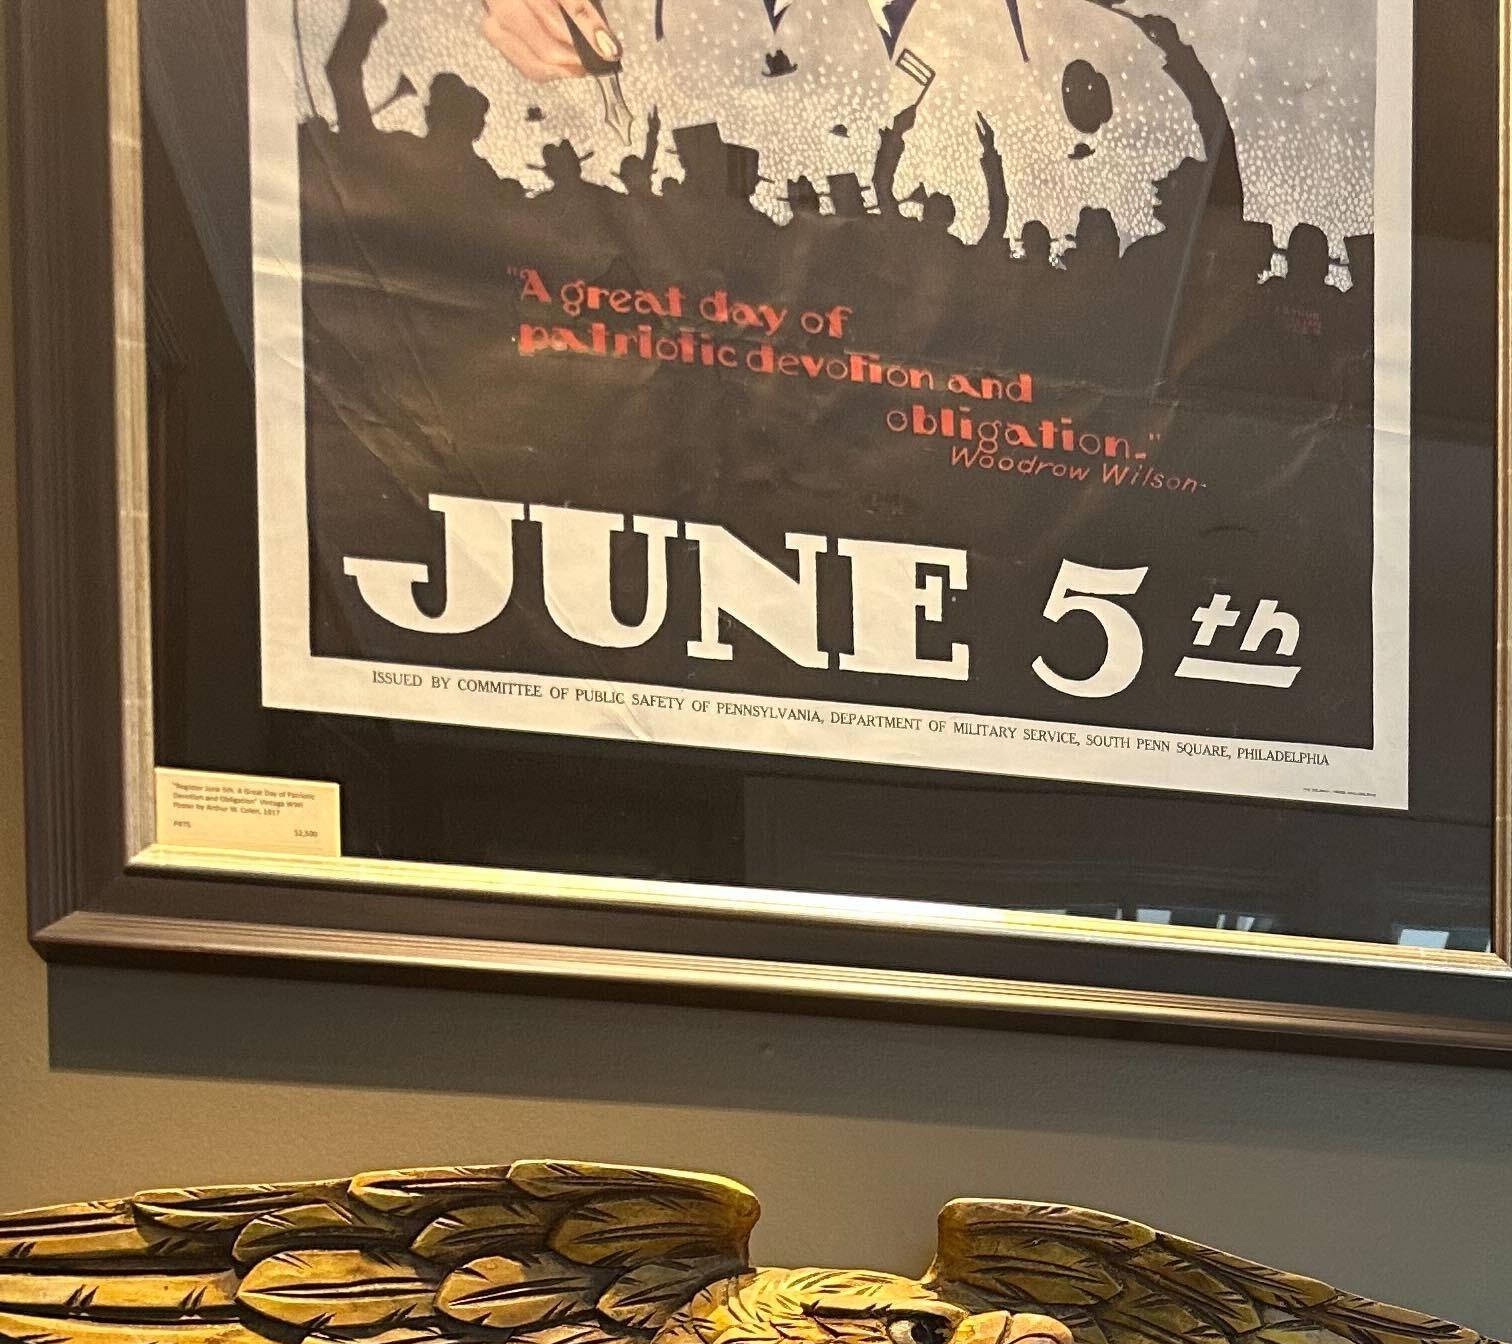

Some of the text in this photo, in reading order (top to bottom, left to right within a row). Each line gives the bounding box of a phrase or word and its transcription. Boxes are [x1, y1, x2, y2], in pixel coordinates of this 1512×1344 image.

[560, 279, 686, 318] great
[700, 289, 787, 335] day
[800, 305, 853, 338] of
[518, 322, 1033, 403] patriotic devotion and
[951, 445, 1091, 481] Woodrow
[344, 493, 970, 682] JUNE
[372, 670, 1330, 766] ISSUED BY COMMITTEE OF PUBLIC SAFETY OF PENNSYLVANIA, DEPARTMENT OF MILITARY SERVICE, SOUTH PENN SQUARE, PHILADELPHIA
